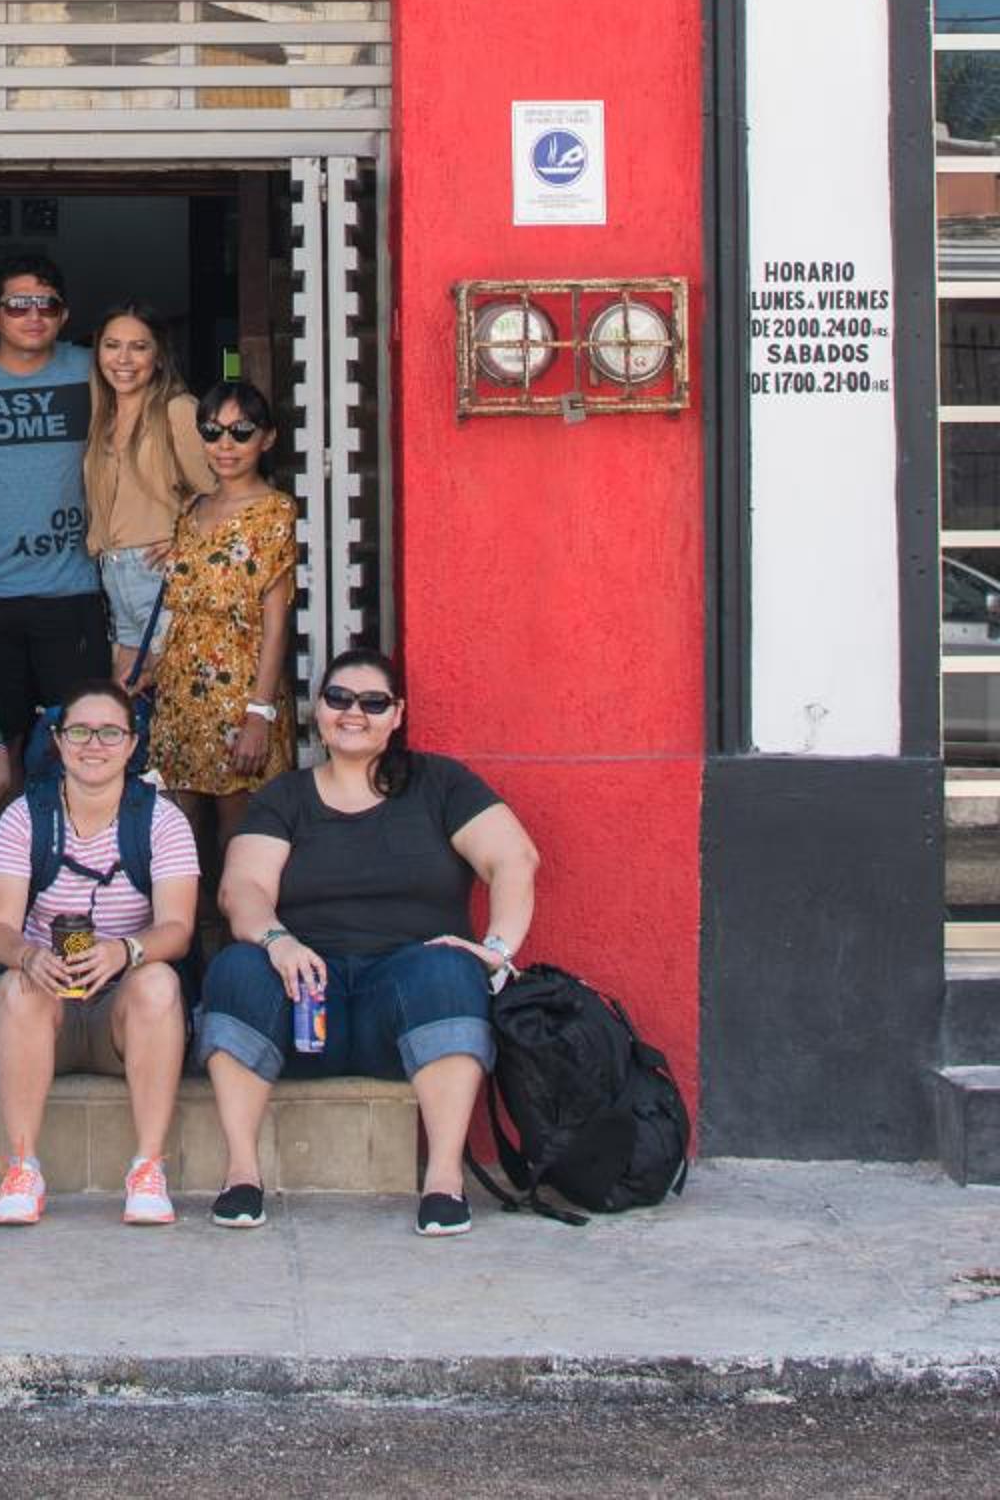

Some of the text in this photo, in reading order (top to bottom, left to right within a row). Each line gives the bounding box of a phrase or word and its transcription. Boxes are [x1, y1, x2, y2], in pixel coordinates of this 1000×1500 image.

[764, 261, 855, 283] HORARIO
[752, 291, 805, 311] LUNES
[817, 289, 889, 311] VIERNES
[752, 319, 770, 338] DE
[767, 343, 869, 364] SABADOS
[752, 372, 770, 394] DE
[52, 507, 82, 531] GO
[12, 529, 83, 557] EASY
